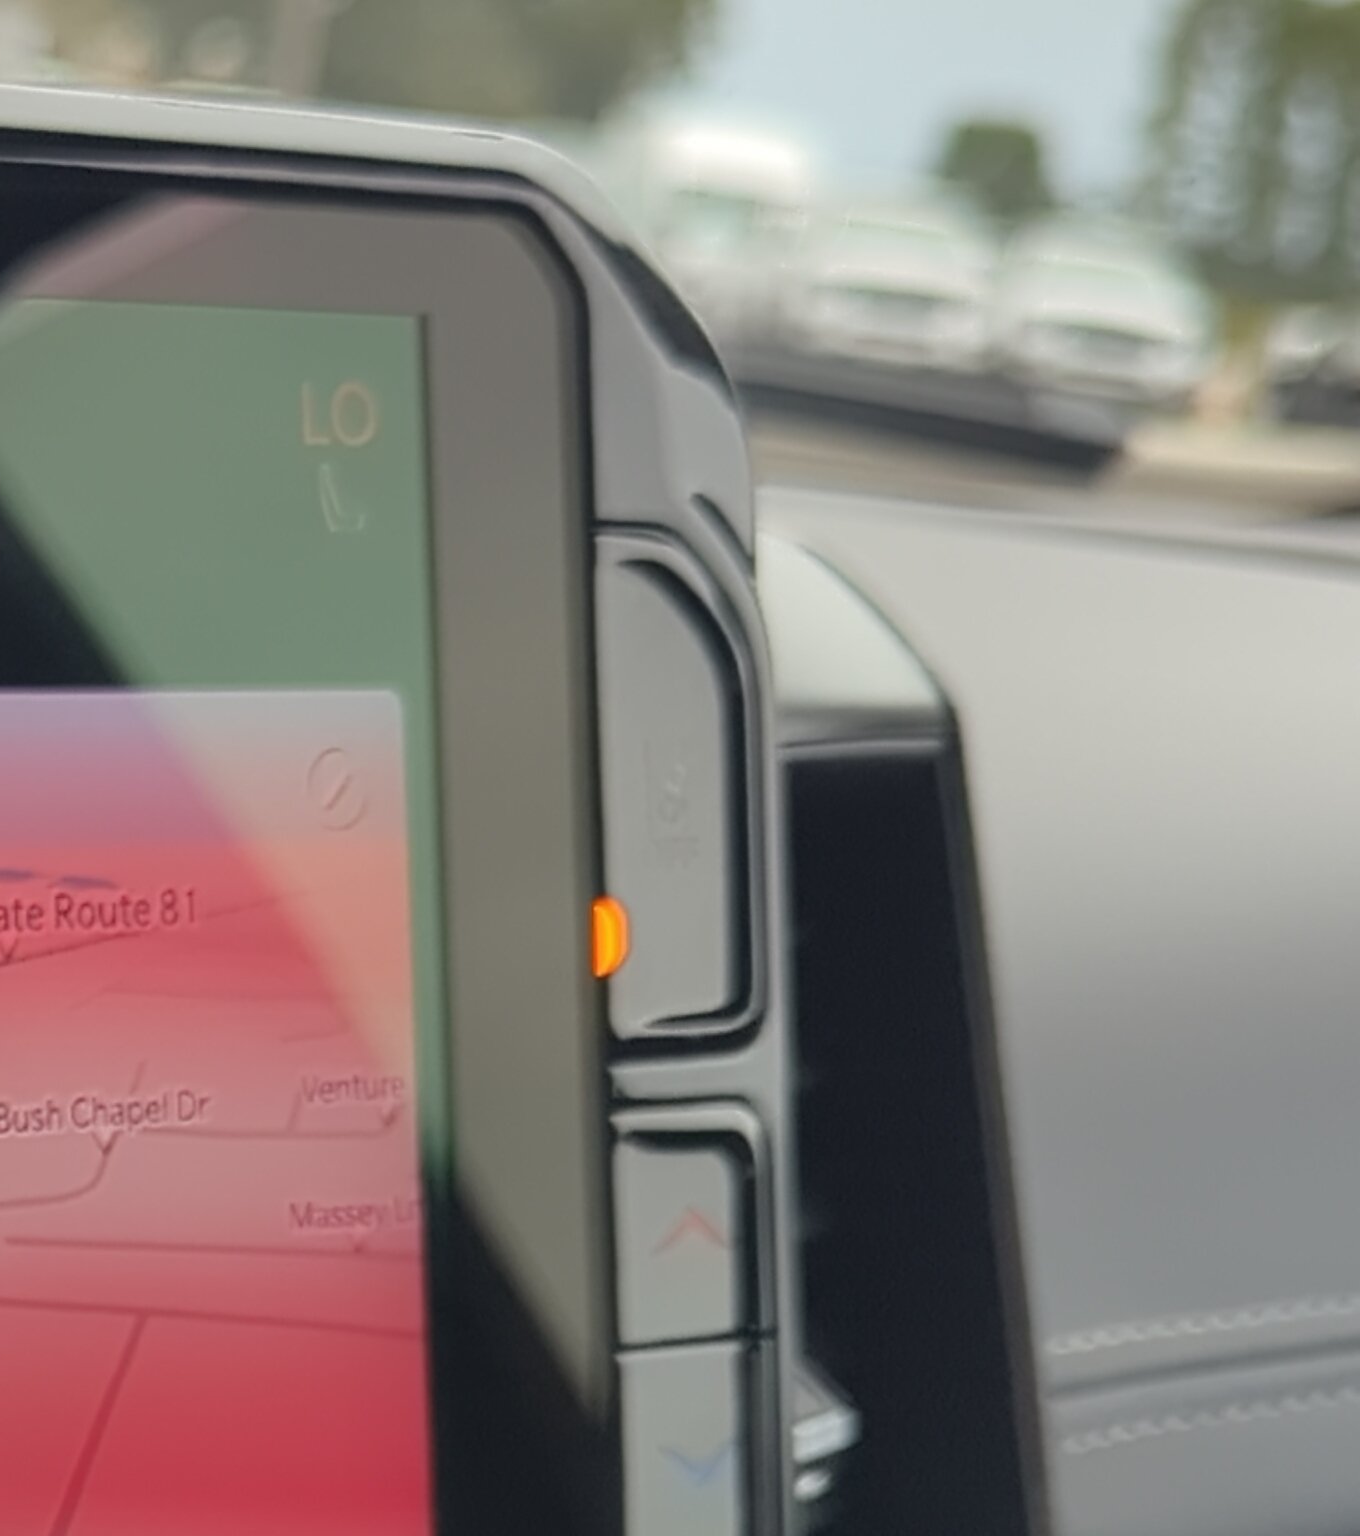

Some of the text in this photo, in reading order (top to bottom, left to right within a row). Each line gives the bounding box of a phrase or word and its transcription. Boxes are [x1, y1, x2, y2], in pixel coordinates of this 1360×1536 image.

[299, 379, 379, 447] LO
[54, 892, 152, 930] Route
[159, 888, 197, 926] 81
[302, 1074, 406, 1105] Venture
[70, 1093, 168, 1132] Chapel
[177, 1090, 211, 1123] Dr
